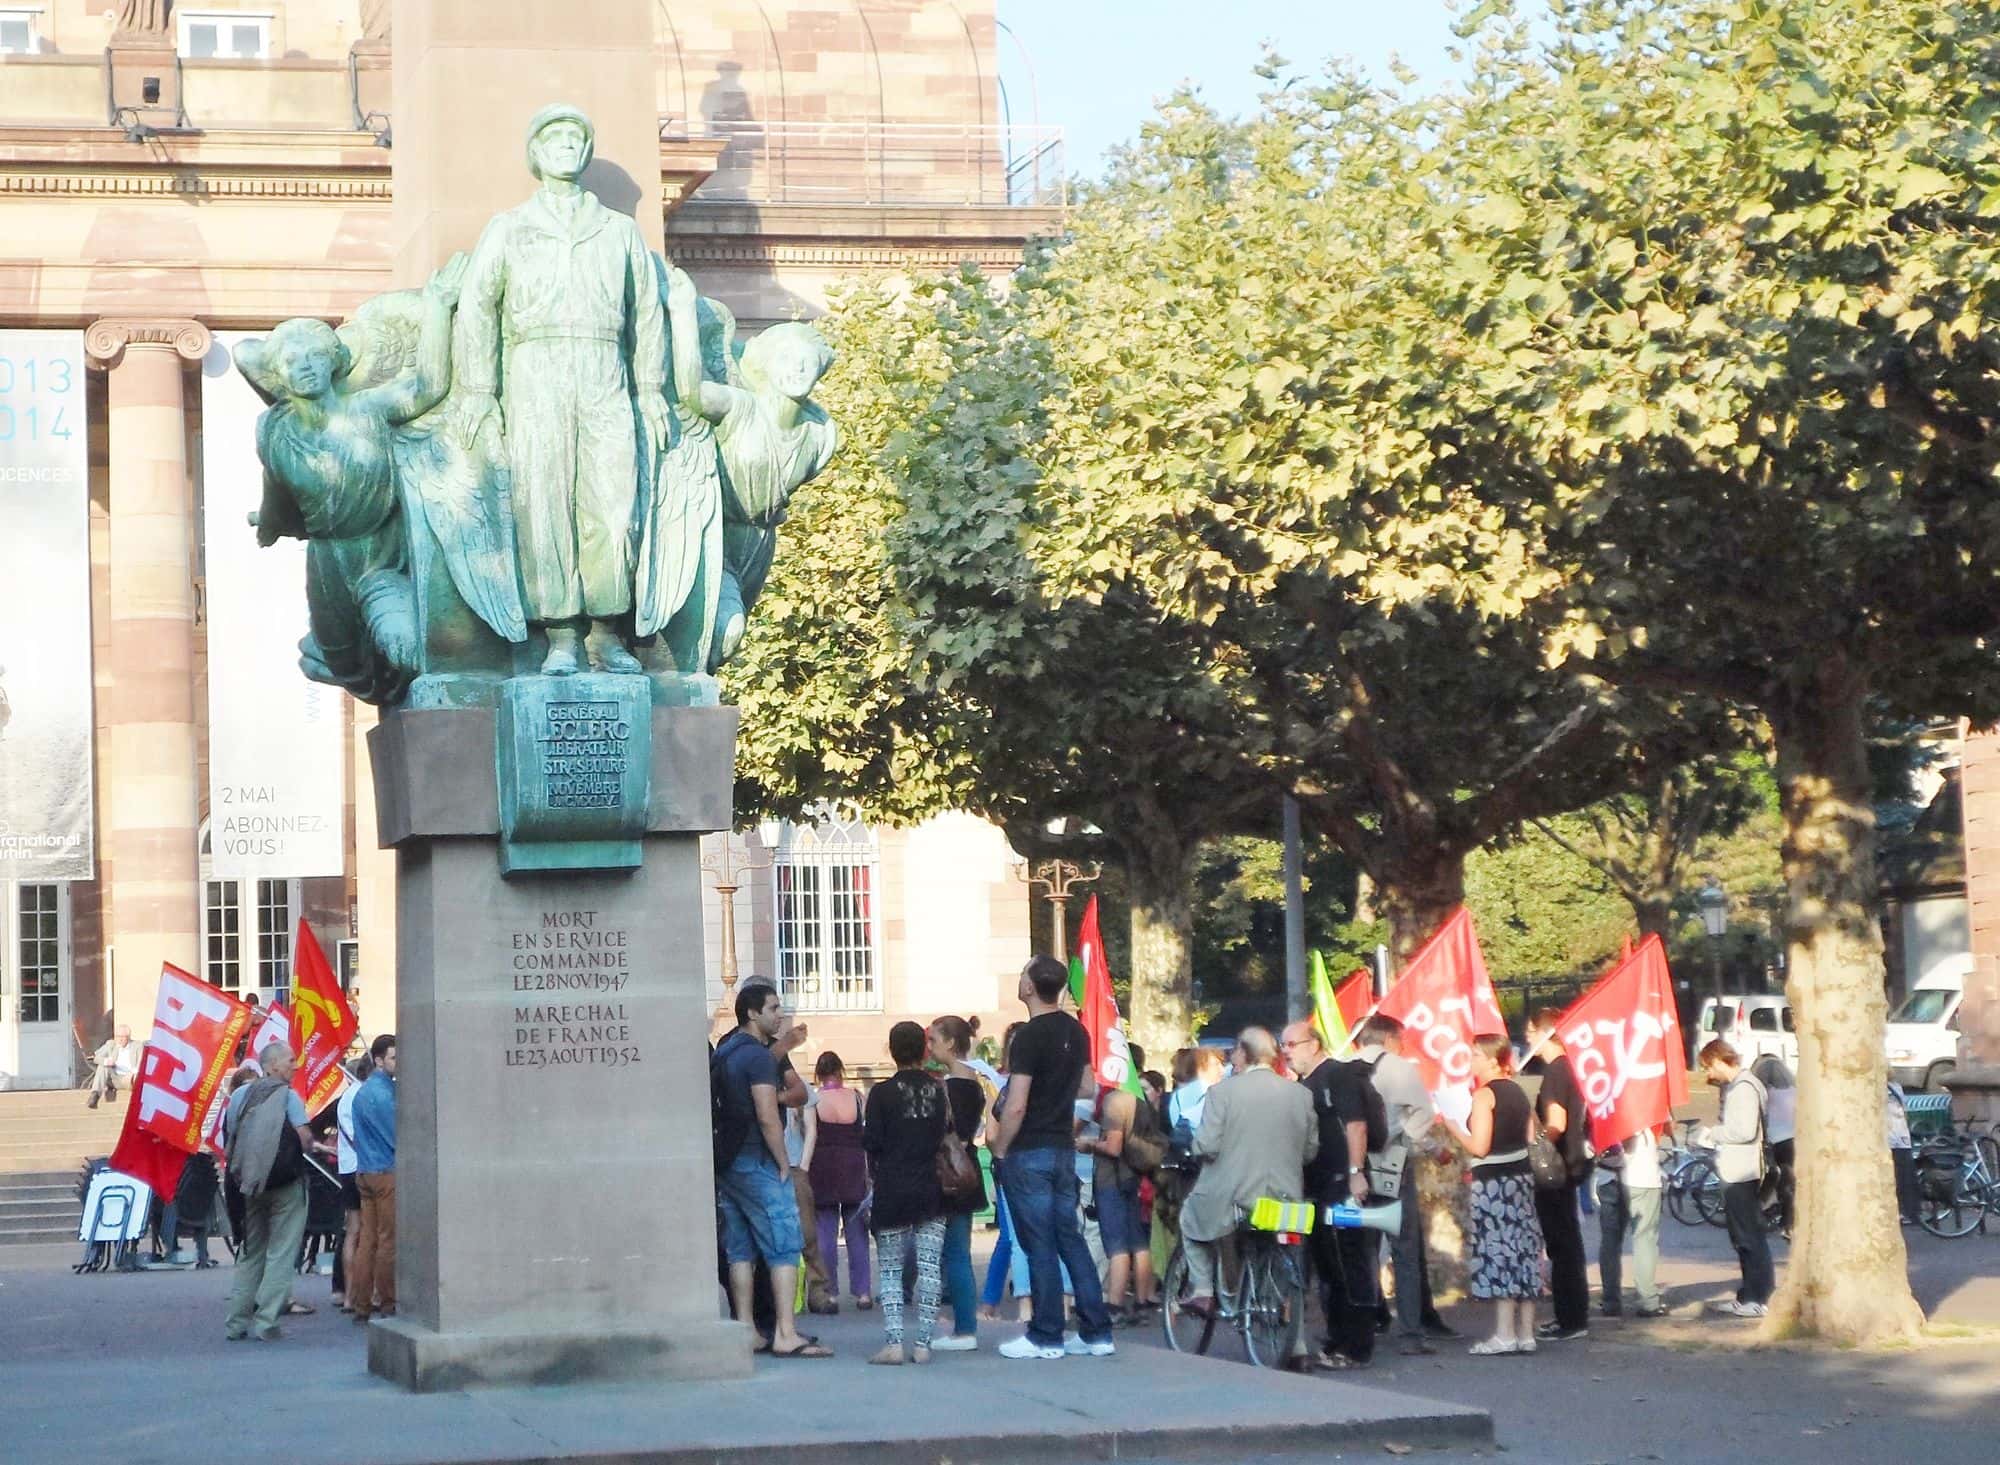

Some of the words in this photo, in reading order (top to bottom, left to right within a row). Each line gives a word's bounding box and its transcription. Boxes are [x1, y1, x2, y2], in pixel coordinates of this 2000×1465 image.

[543, 758, 628, 775] STRASBOURG
[222, 787, 233, 804] 2
[240, 786, 276, 804] MAI
[547, 782, 621, 796] NOVEMBRE
[542, 911, 598, 930] MORT
[512, 933, 538, 950] EN
[542, 930, 627, 951] SERVICE
[514, 1004, 630, 1025] MARECHAL
[515, 1028, 541, 1044] DE
[547, 1025, 630, 1045] FRANCE
